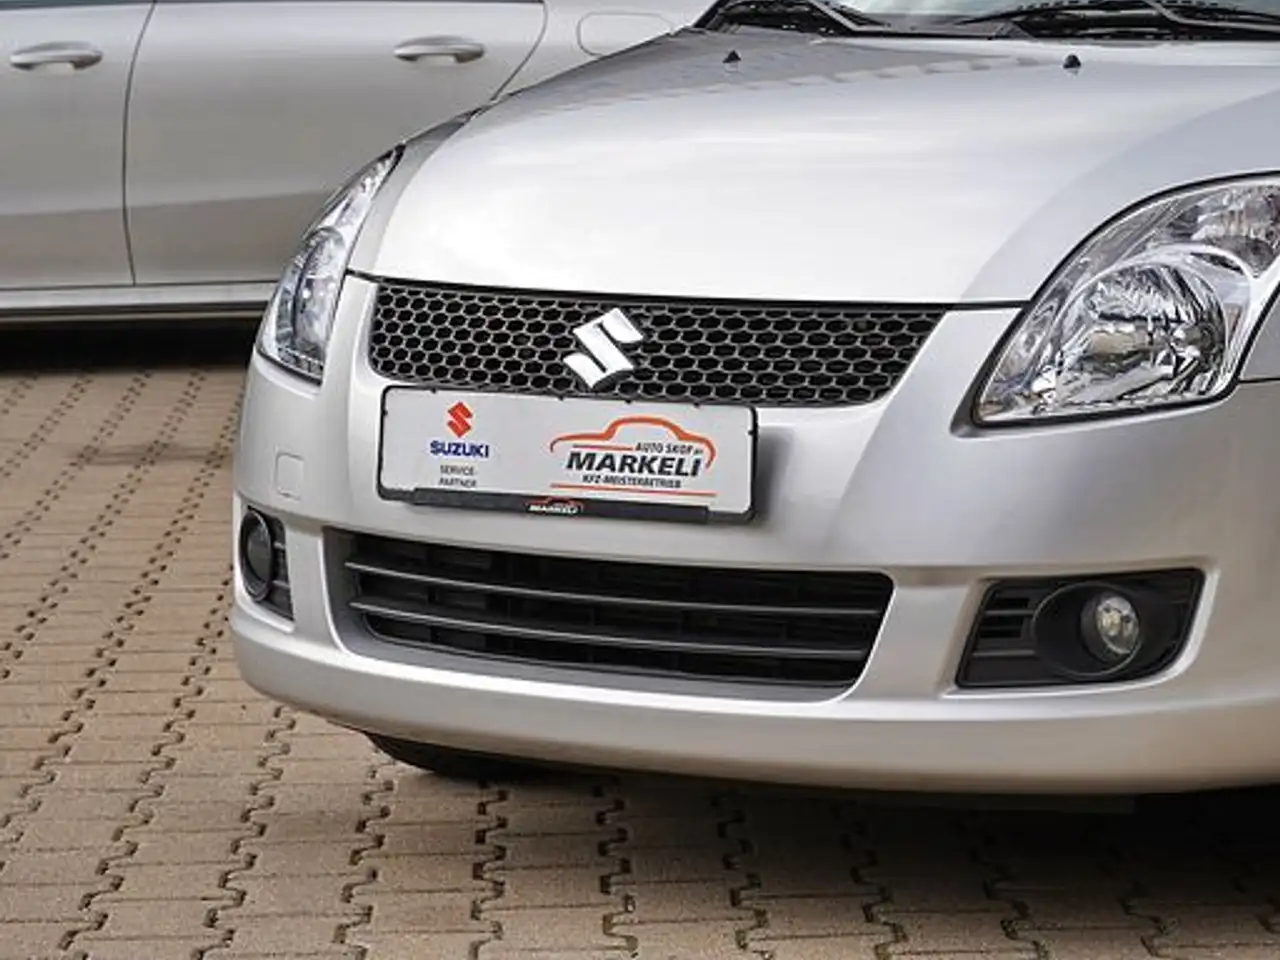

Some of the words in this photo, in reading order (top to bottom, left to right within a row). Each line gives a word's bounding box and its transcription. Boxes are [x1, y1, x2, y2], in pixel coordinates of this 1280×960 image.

[429, 440, 490, 459] SUZUKI
[635, 442, 664, 454] AUTO
[666, 443, 693, 456] SKOF
[565, 452, 703, 477] MARKELI
[439, 477, 477, 489] PARTNER
[528, 504, 579, 515] MARKELI
